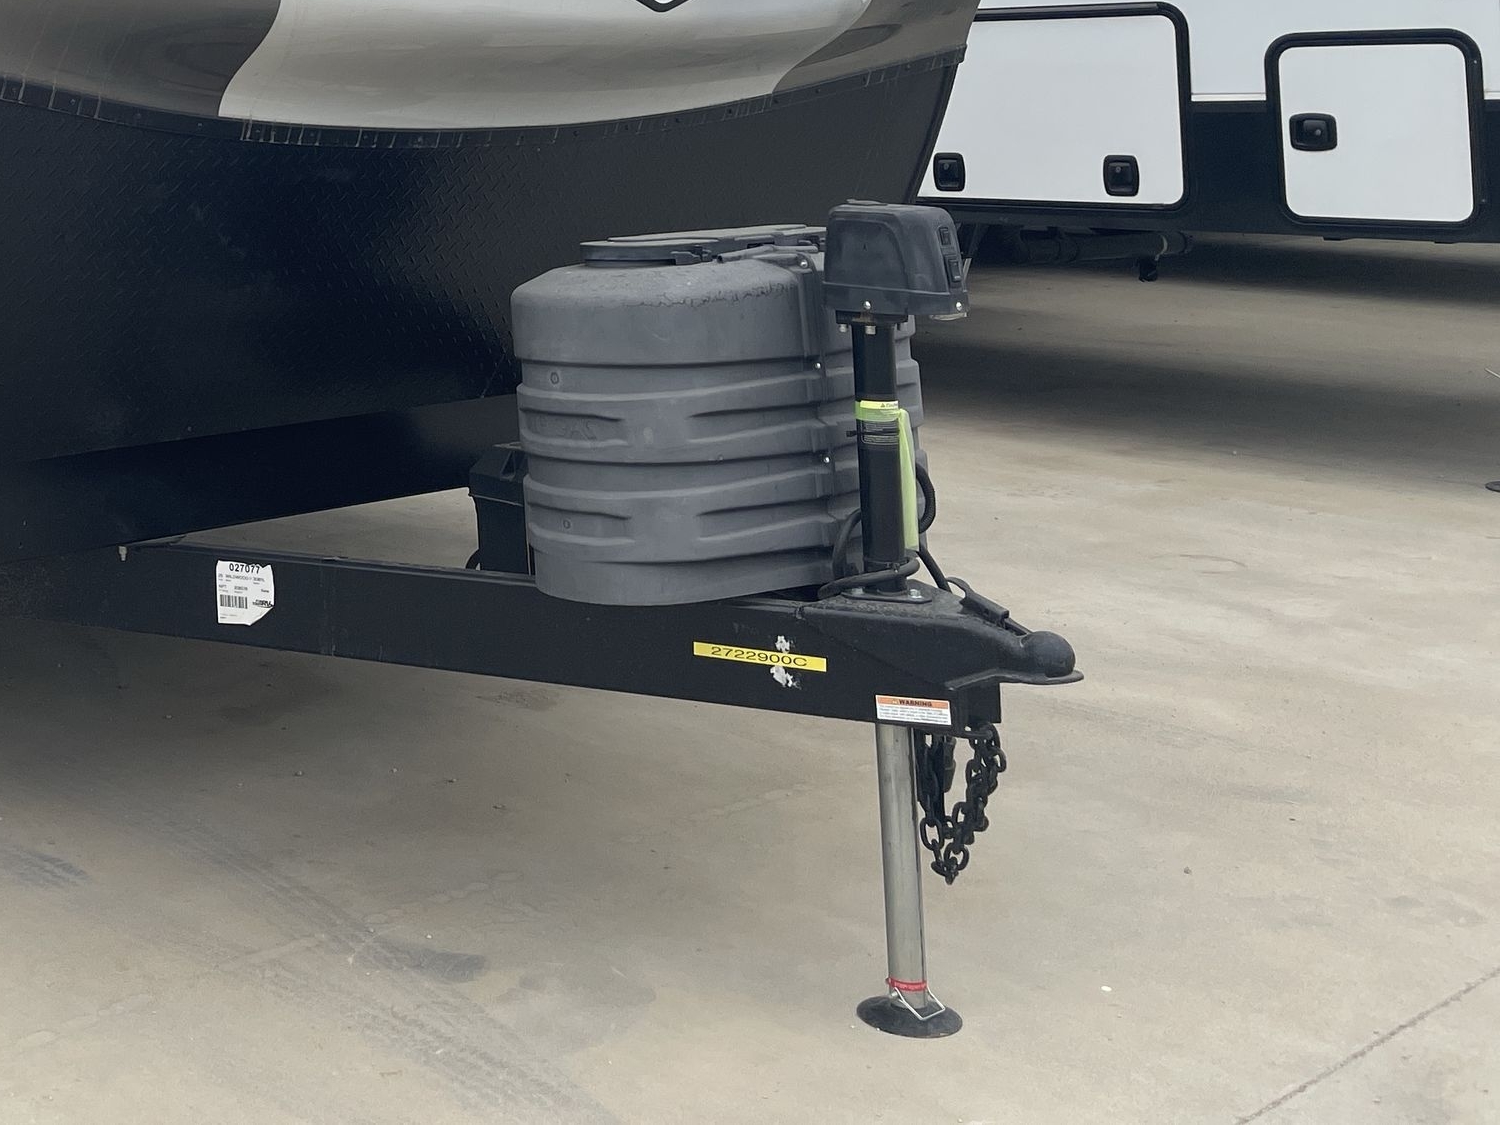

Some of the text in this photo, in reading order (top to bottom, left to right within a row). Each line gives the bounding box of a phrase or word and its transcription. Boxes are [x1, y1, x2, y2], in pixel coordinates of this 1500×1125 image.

[229, 563, 260, 574] 027077
[711, 645, 807, 667] 2722900C
[899, 699, 932, 707] WARNING
